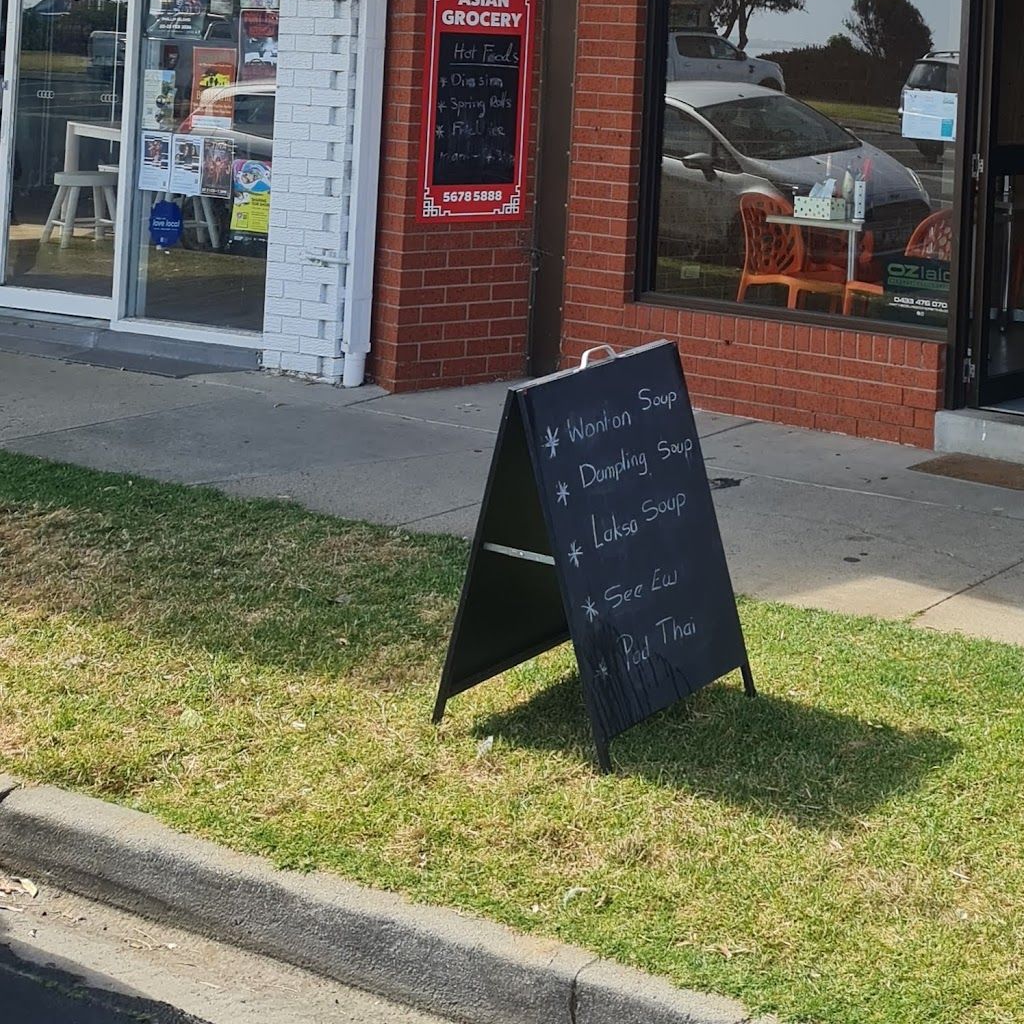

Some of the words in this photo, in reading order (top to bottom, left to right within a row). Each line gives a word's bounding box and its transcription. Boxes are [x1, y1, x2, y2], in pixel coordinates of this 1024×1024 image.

[441, 9, 523, 28] GROCERY
[453, 42, 477, 60] Hot
[482, 42, 519, 63] Foods
[450, 96, 486, 119] Spring
[443, 192, 472, 203] 5678
[473, 190, 503, 202] 5888
[566, 408, 632, 443] Wonton
[638, 388, 677, 411] Soup
[578, 447, 648, 488] Dumpling
[657, 438, 693, 461] Soup
[591, 513, 638, 549] Laksa
[641, 492, 687, 522] Soup
[604, 584, 643, 609] See
[616, 632, 650, 672] Pad
[655, 616, 697, 646] Thai
